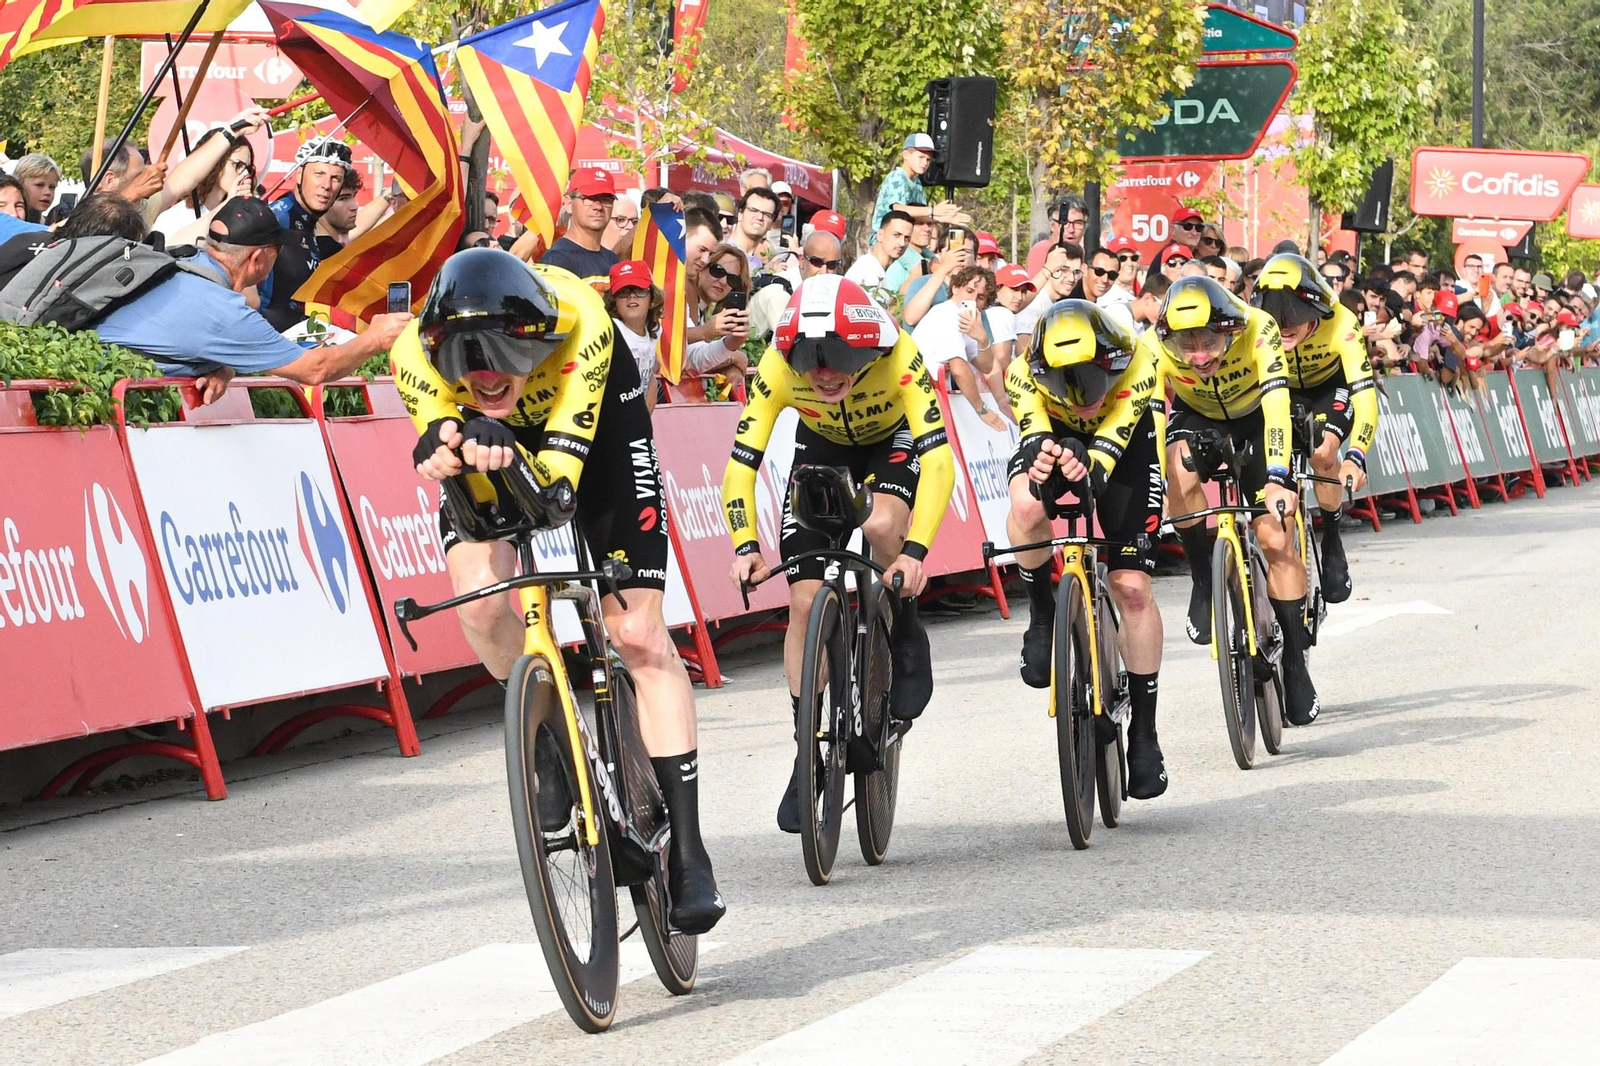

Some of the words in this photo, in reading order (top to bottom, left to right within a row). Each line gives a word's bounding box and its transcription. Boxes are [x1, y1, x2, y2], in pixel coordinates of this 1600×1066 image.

[1462, 171, 1560, 197] Cofidis
[1131, 214, 1169, 242] 50
[855, 308, 884, 320] BYGMA
[401, 367, 438, 397] VISMA
[1010, 373, 1037, 394] VISMA
[827, 401, 894, 422] VISMA
[547, 437, 590, 456] SRAM
[629, 438, 656, 499] VISMA
[879, 482, 912, 498] nimbl
[1147, 464, 1162, 508] VISMA
[161, 501, 298, 605] Carrefour
